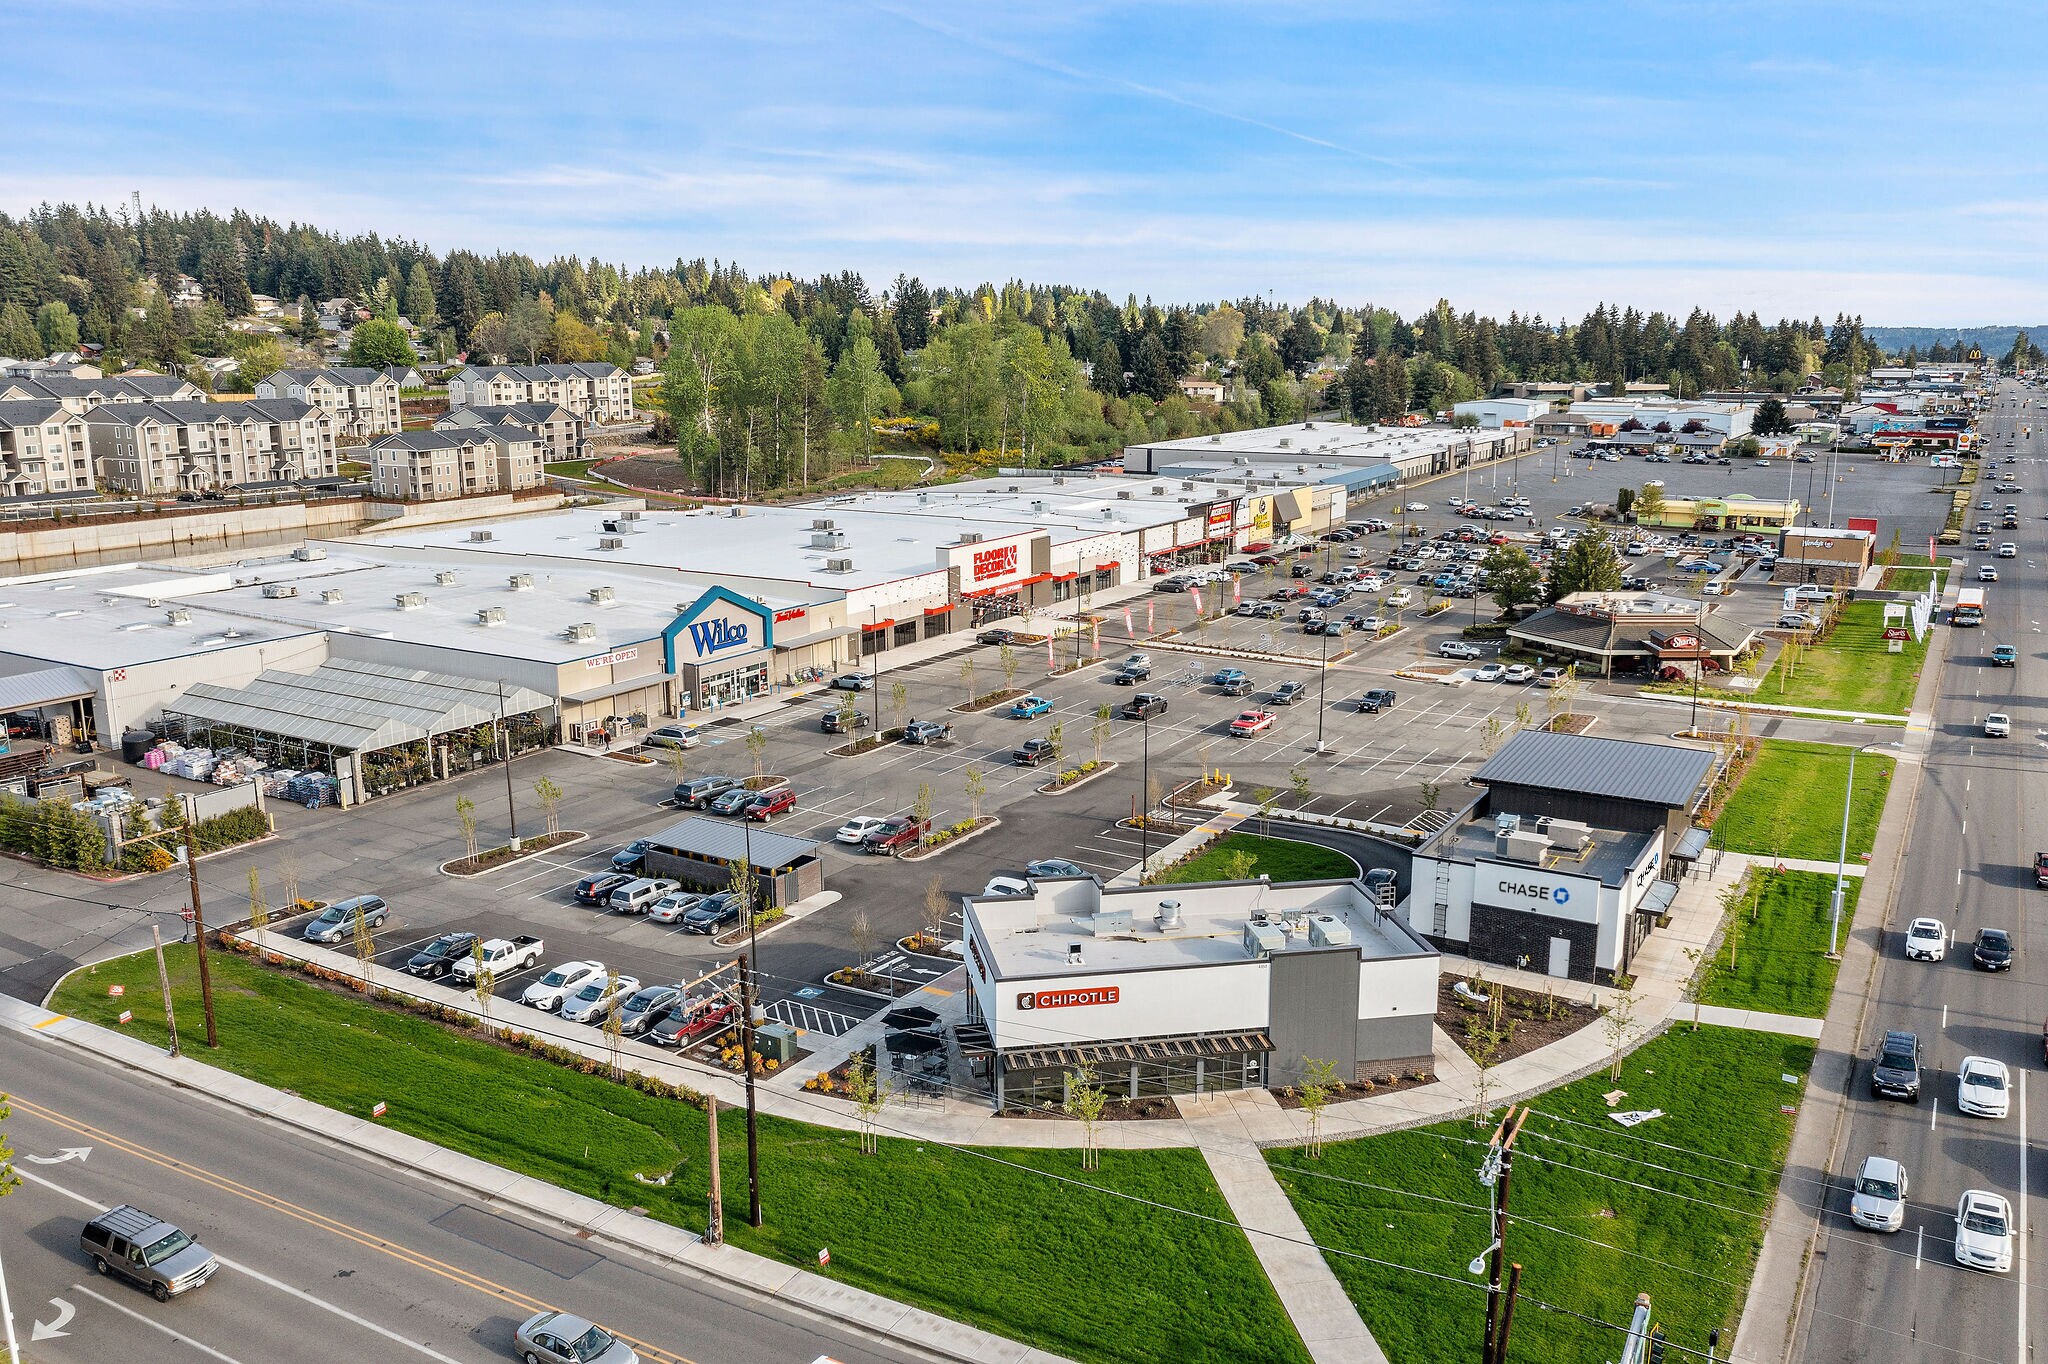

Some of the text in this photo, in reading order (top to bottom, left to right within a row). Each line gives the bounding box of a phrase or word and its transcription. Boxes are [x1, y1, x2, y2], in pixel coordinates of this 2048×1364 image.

[1802, 539, 1824, 548] Wendy's
[973, 547, 1004, 564] FLOOR
[973, 560, 1004, 577] DECOR
[688, 617, 748, 657] Wilco
[587, 650, 636, 667] WE'RE OPEN
[1498, 881, 1550, 901] CHASE
[1040, 990, 1117, 1006] CHIPOTLE
